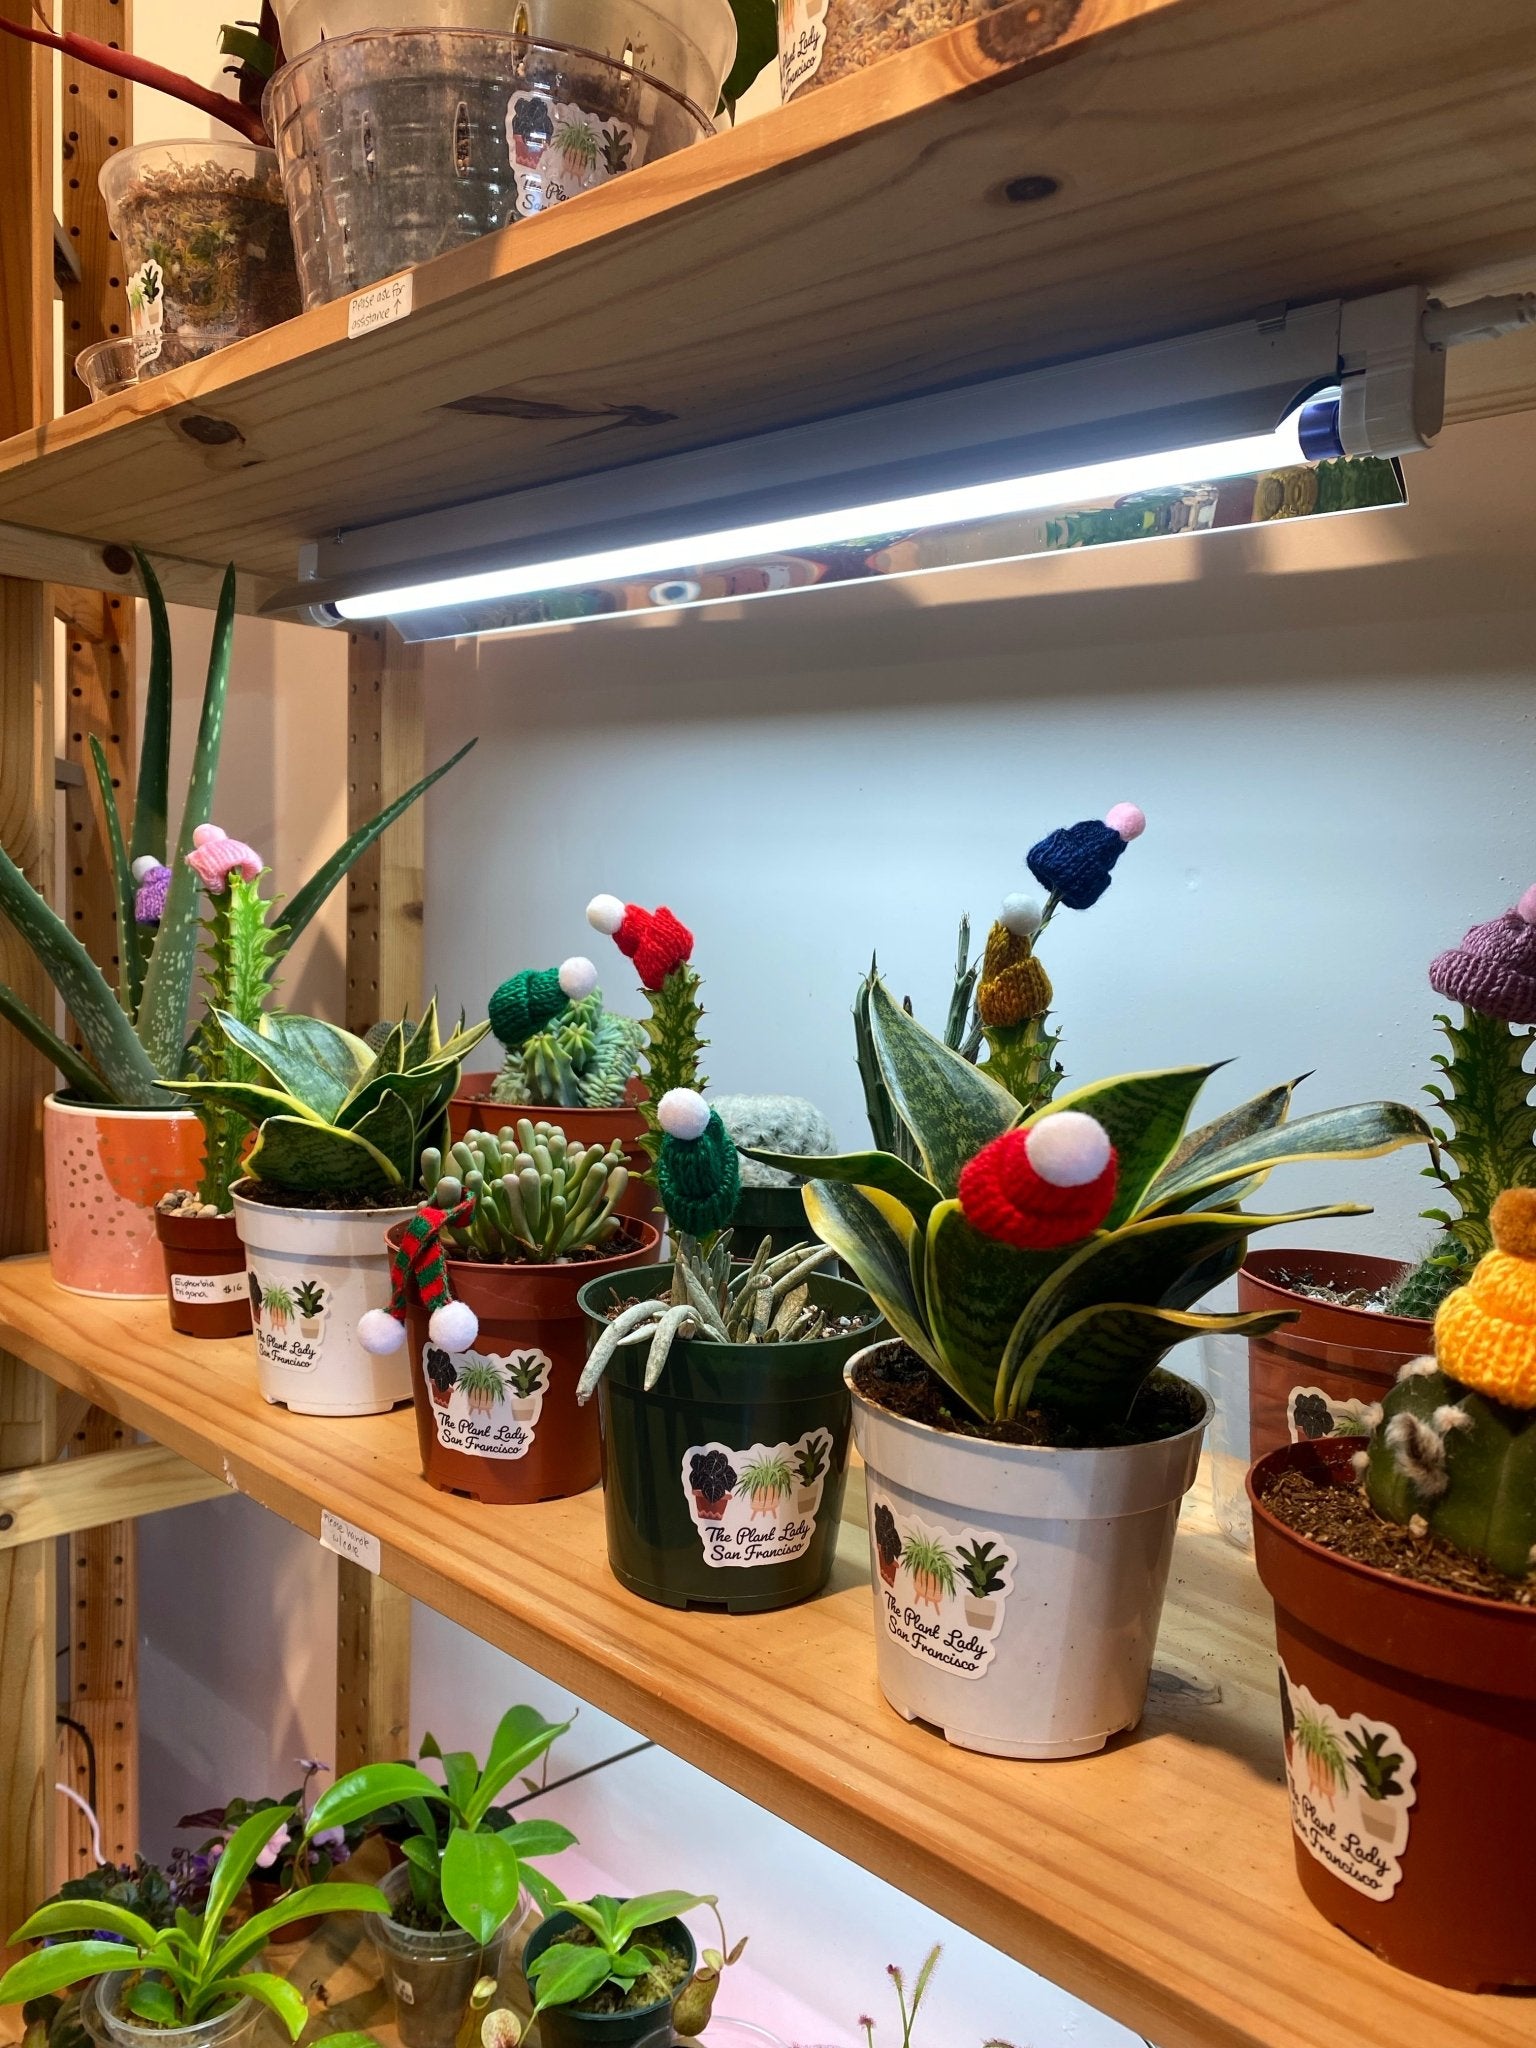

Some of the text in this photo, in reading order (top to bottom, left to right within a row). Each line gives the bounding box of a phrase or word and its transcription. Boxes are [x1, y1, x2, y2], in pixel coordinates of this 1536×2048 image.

[797, 25, 820, 58] Lady
[546, 181, 570, 201] Pla
[352, 282, 406, 311] Please ask for
[174, 1277, 215, 1290] Euphorbia
[222, 1283, 243, 1294] $16
[256, 1328, 317, 1360] The Plant Lady
[259, 1343, 313, 1368] San Francisco
[438, 1412, 529, 1445] The Plant Lady
[441, 1429, 522, 1454] San Francisco
[705, 1519, 811, 1546] The Plant Lady
[710, 1543, 805, 1561] San Francisco
[884, 1590, 988, 1660] The Plant Lady
[888, 1614, 980, 1672] San Francisco
[1301, 1794, 1337, 1841] Plant
[1340, 1833, 1392, 1878] Lady
[1309, 1826, 1383, 1890] Francisco
